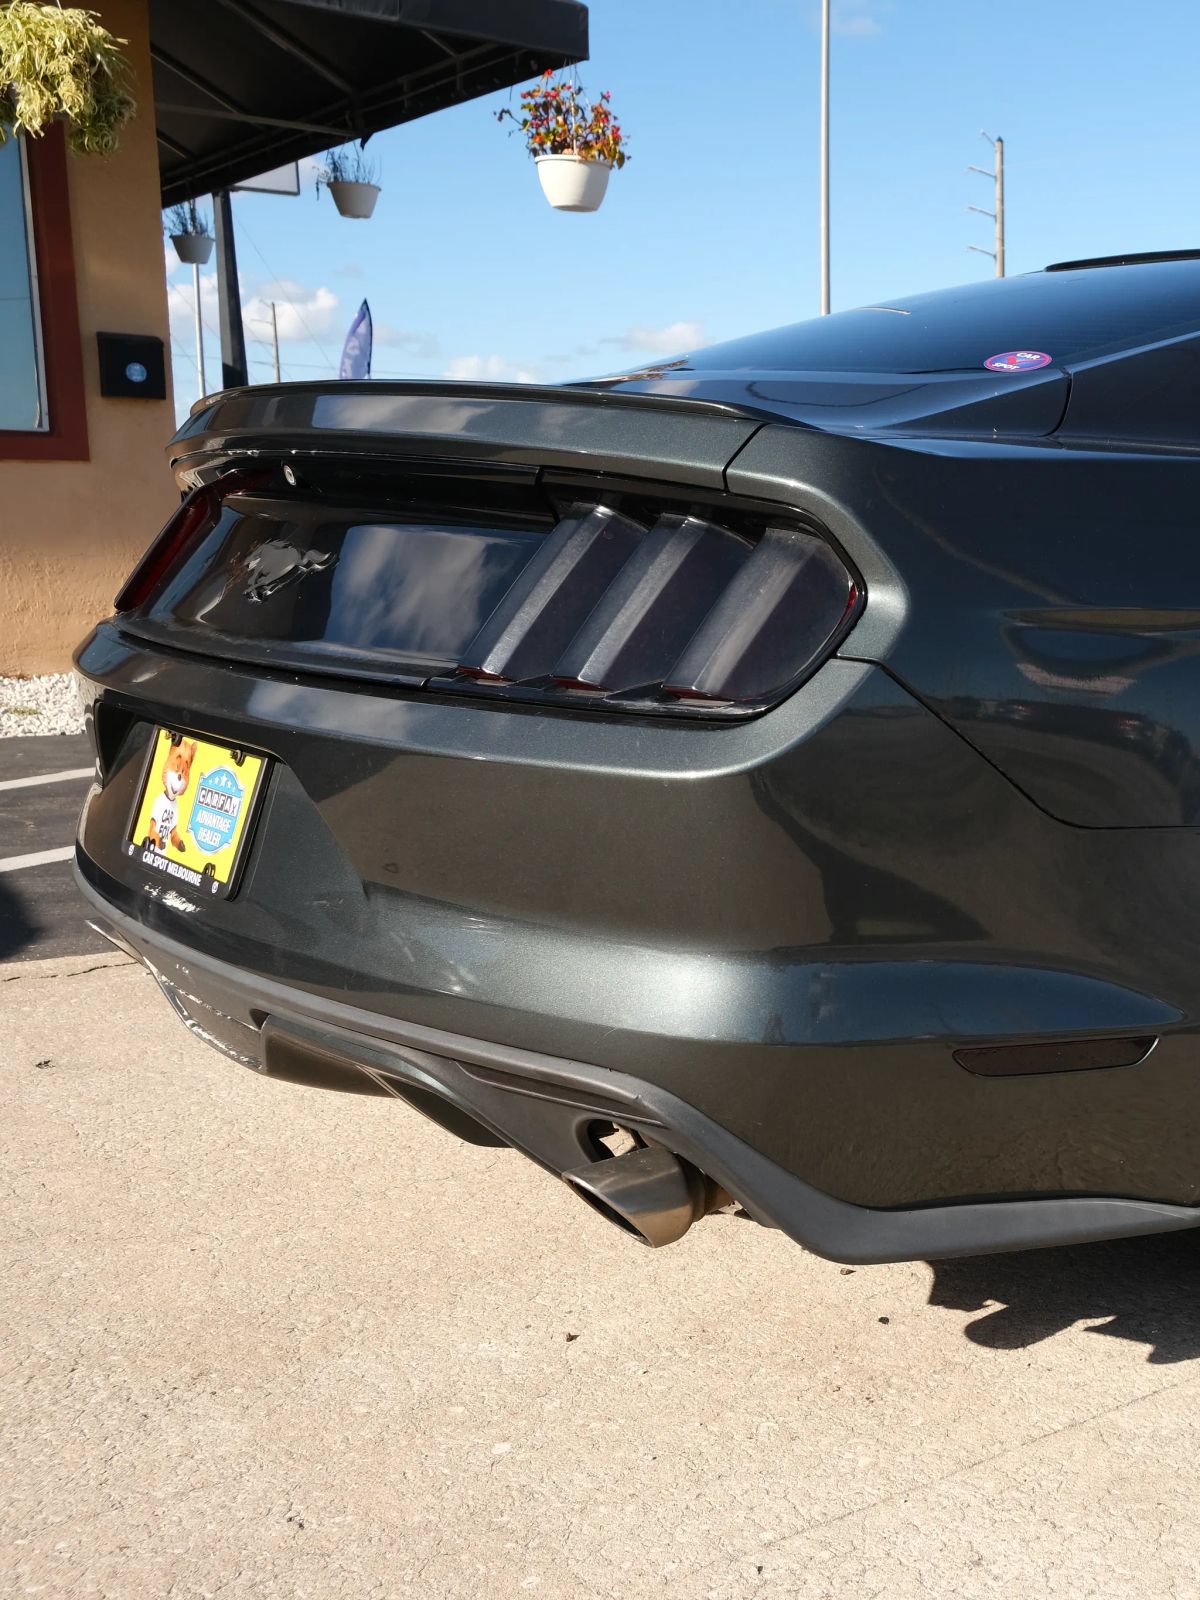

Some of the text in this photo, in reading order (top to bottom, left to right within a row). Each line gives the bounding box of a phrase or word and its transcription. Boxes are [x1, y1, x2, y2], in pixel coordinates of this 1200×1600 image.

[161, 809, 174, 823] CAR
[198, 787, 240, 817] CARFAX
[142, 851, 202, 887] CAR SPOT MELBOURNE
